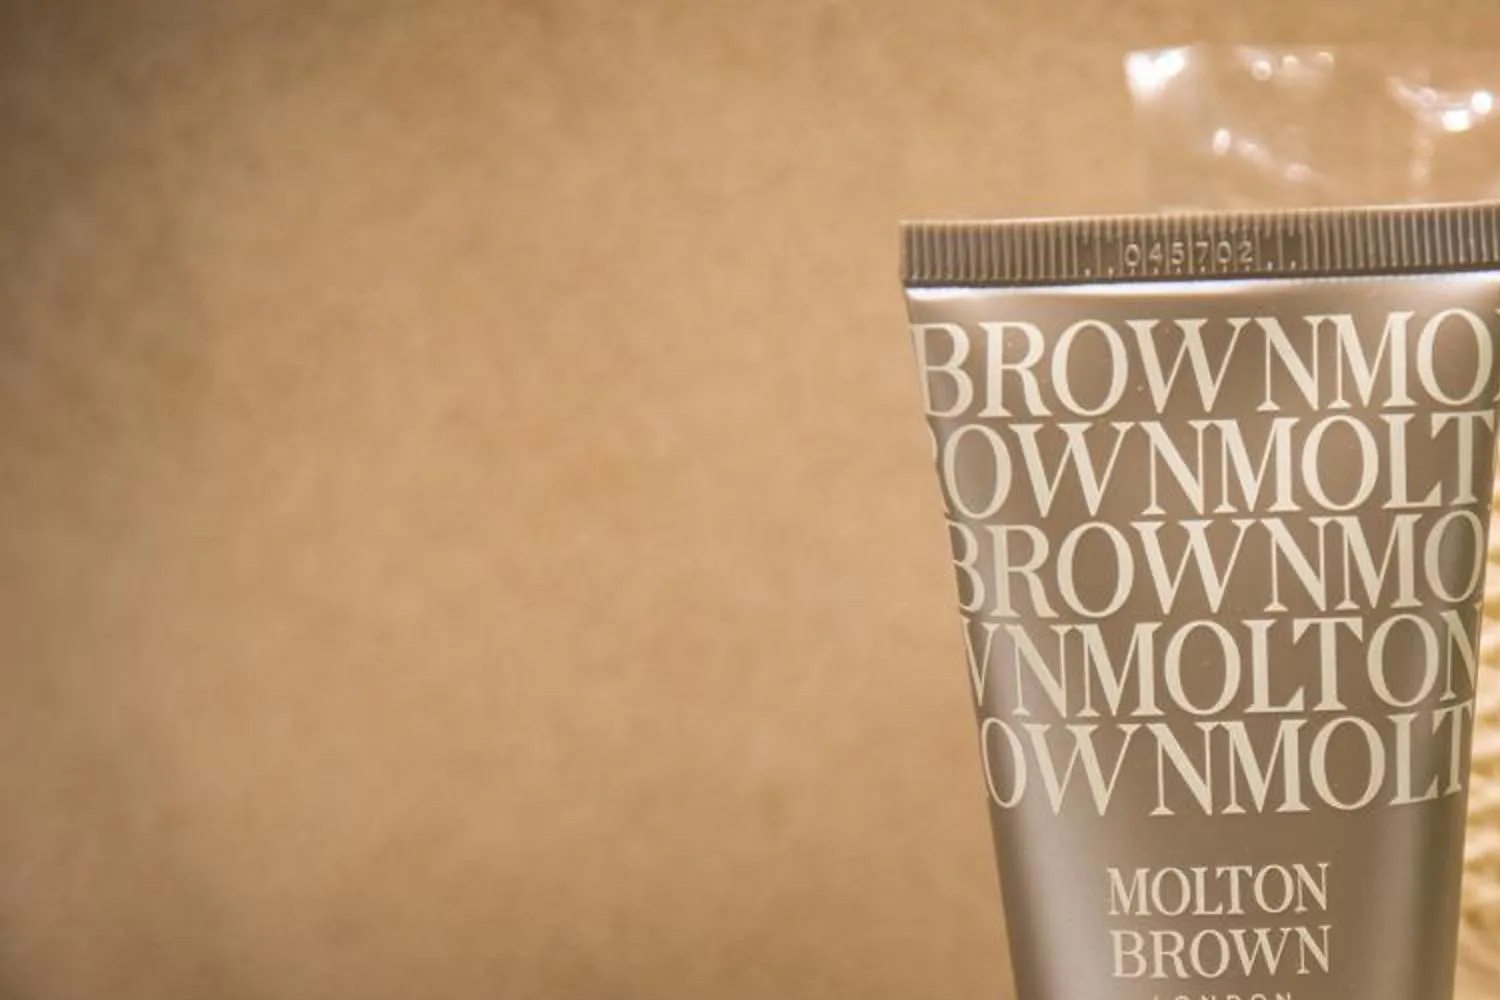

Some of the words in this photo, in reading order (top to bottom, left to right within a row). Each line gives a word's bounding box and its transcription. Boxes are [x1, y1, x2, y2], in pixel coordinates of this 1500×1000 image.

[1123, 240, 1253, 267] 045702
[1106, 863, 1330, 916] MOLTON
[1110, 925, 1332, 979] BROWN
